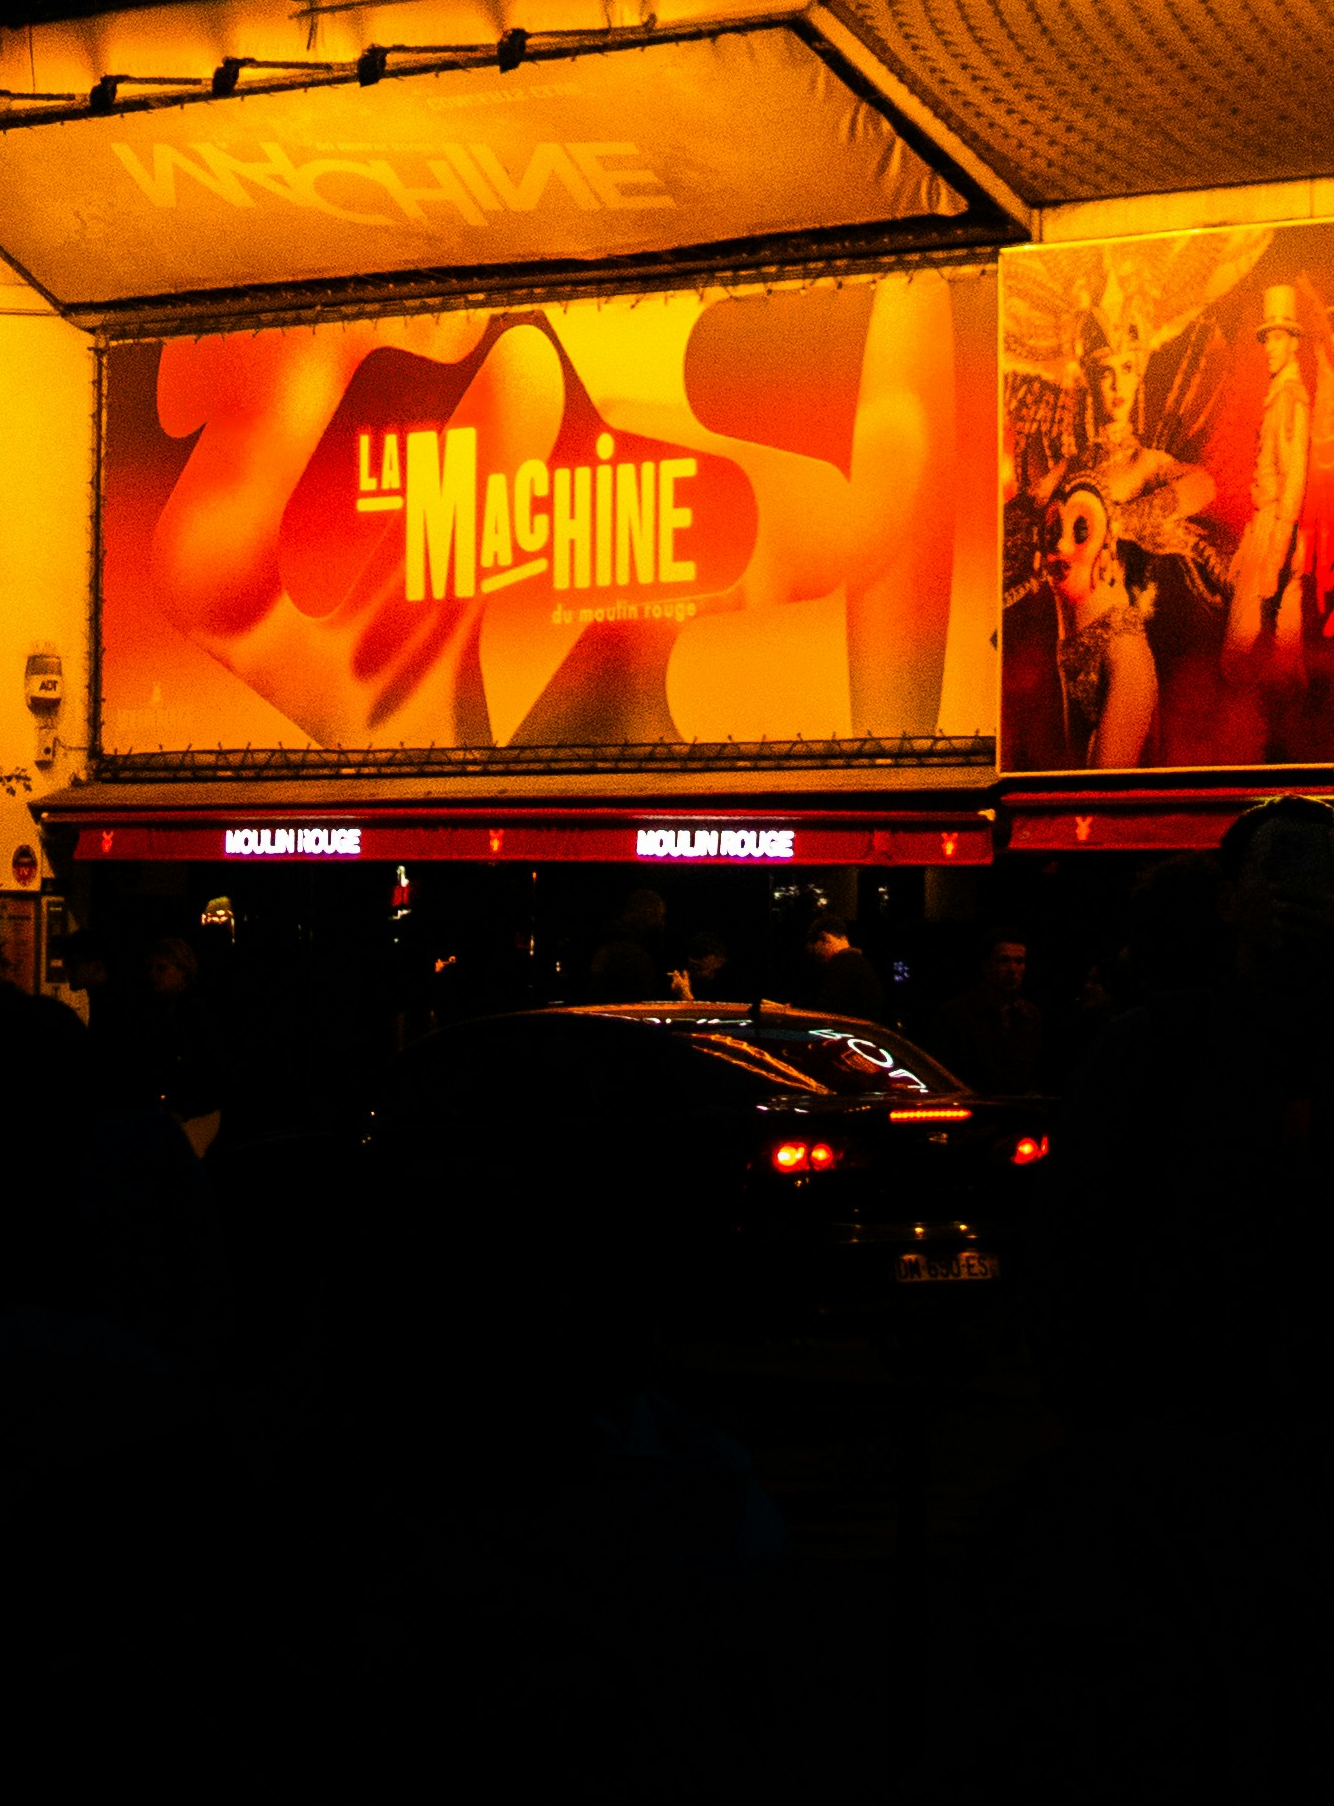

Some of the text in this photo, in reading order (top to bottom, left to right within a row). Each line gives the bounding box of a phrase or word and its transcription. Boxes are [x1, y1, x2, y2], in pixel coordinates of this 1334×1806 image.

[358, 434, 402, 492] LA
[552, 599, 698, 625] du moulin rouge
[225, 828, 362, 855] MOULIN ROUGE
[636, 829, 796, 858] MOULIN ROUGE
